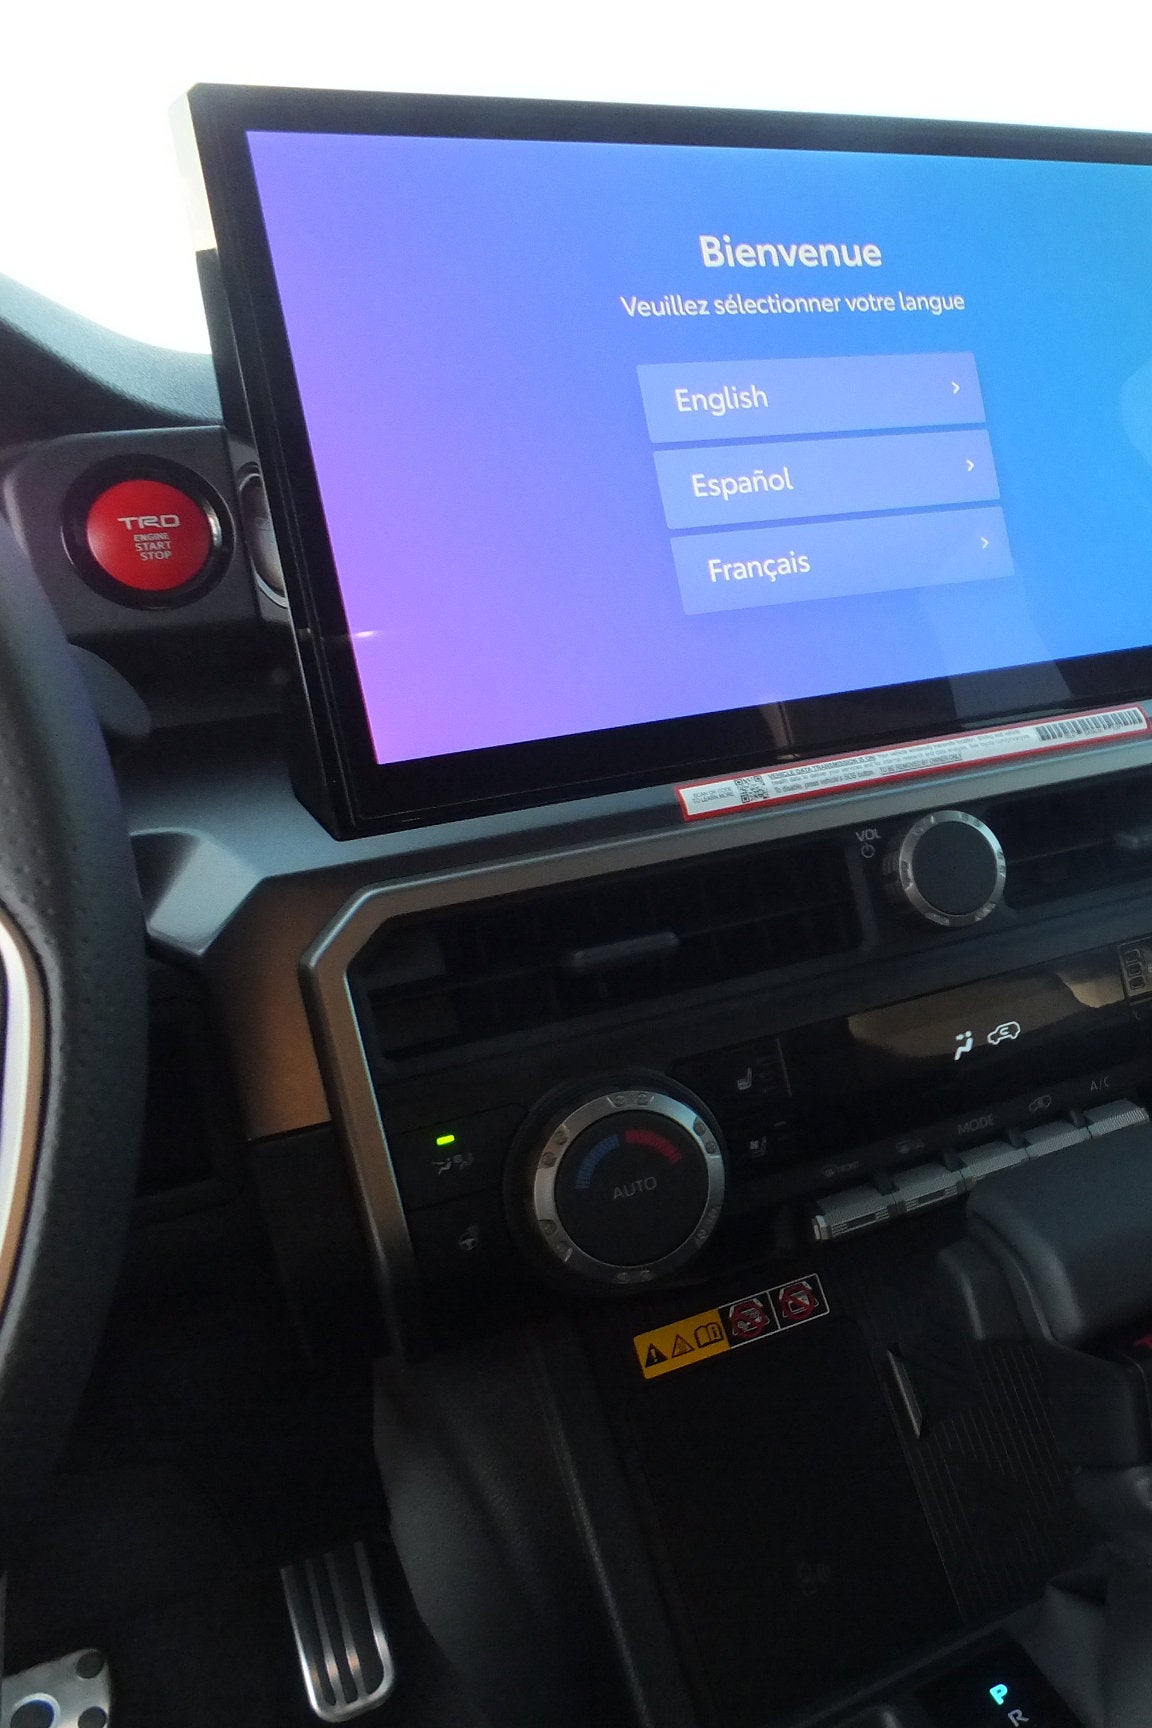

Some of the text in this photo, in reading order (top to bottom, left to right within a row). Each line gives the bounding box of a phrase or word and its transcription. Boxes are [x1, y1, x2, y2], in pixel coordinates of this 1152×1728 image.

[699, 234, 883, 268] Bienvenue
[620, 291, 965, 317] Veuillez sélectionner votre langue
[674, 385, 769, 417] English
[691, 467, 794, 501] Español
[117, 514, 180, 530] TRD
[133, 532, 170, 542] ENGINE
[135, 541, 171, 551] START
[141, 551, 172, 561] STOP
[707, 551, 811, 583] Français
[796, 766, 811, 775] DATA
[855, 828, 880, 842] VOL
[1089, 1073, 1112, 1093] A/C
[957, 1113, 996, 1134] MODE
[612, 1175, 658, 1201] AUTO
[989, 1683, 1008, 1705] P
[1007, 1709, 1030, 1727] R
